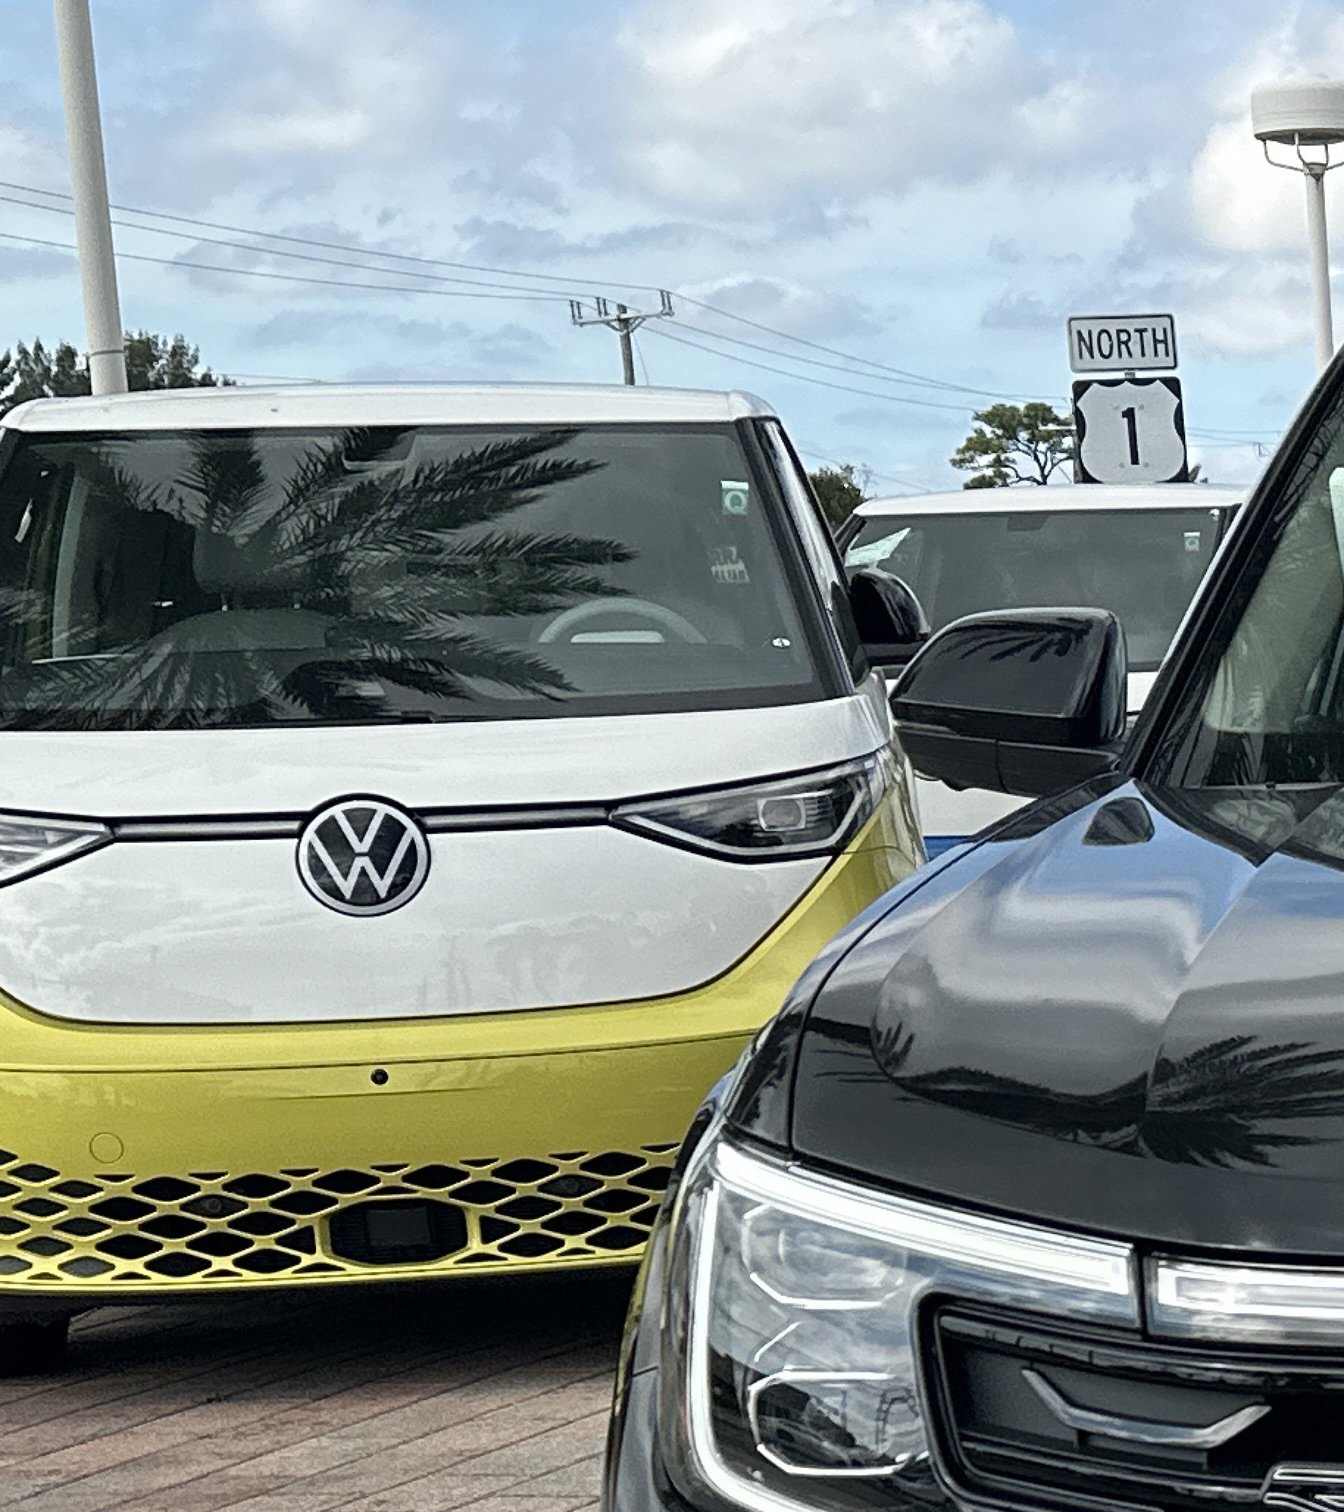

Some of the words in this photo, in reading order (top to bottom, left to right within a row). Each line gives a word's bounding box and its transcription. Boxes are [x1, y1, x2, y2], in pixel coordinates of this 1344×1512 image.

[1076, 327, 1170, 360] NORTH
[1121, 406, 1140, 466] 1
[303, 802, 421, 908] VW
